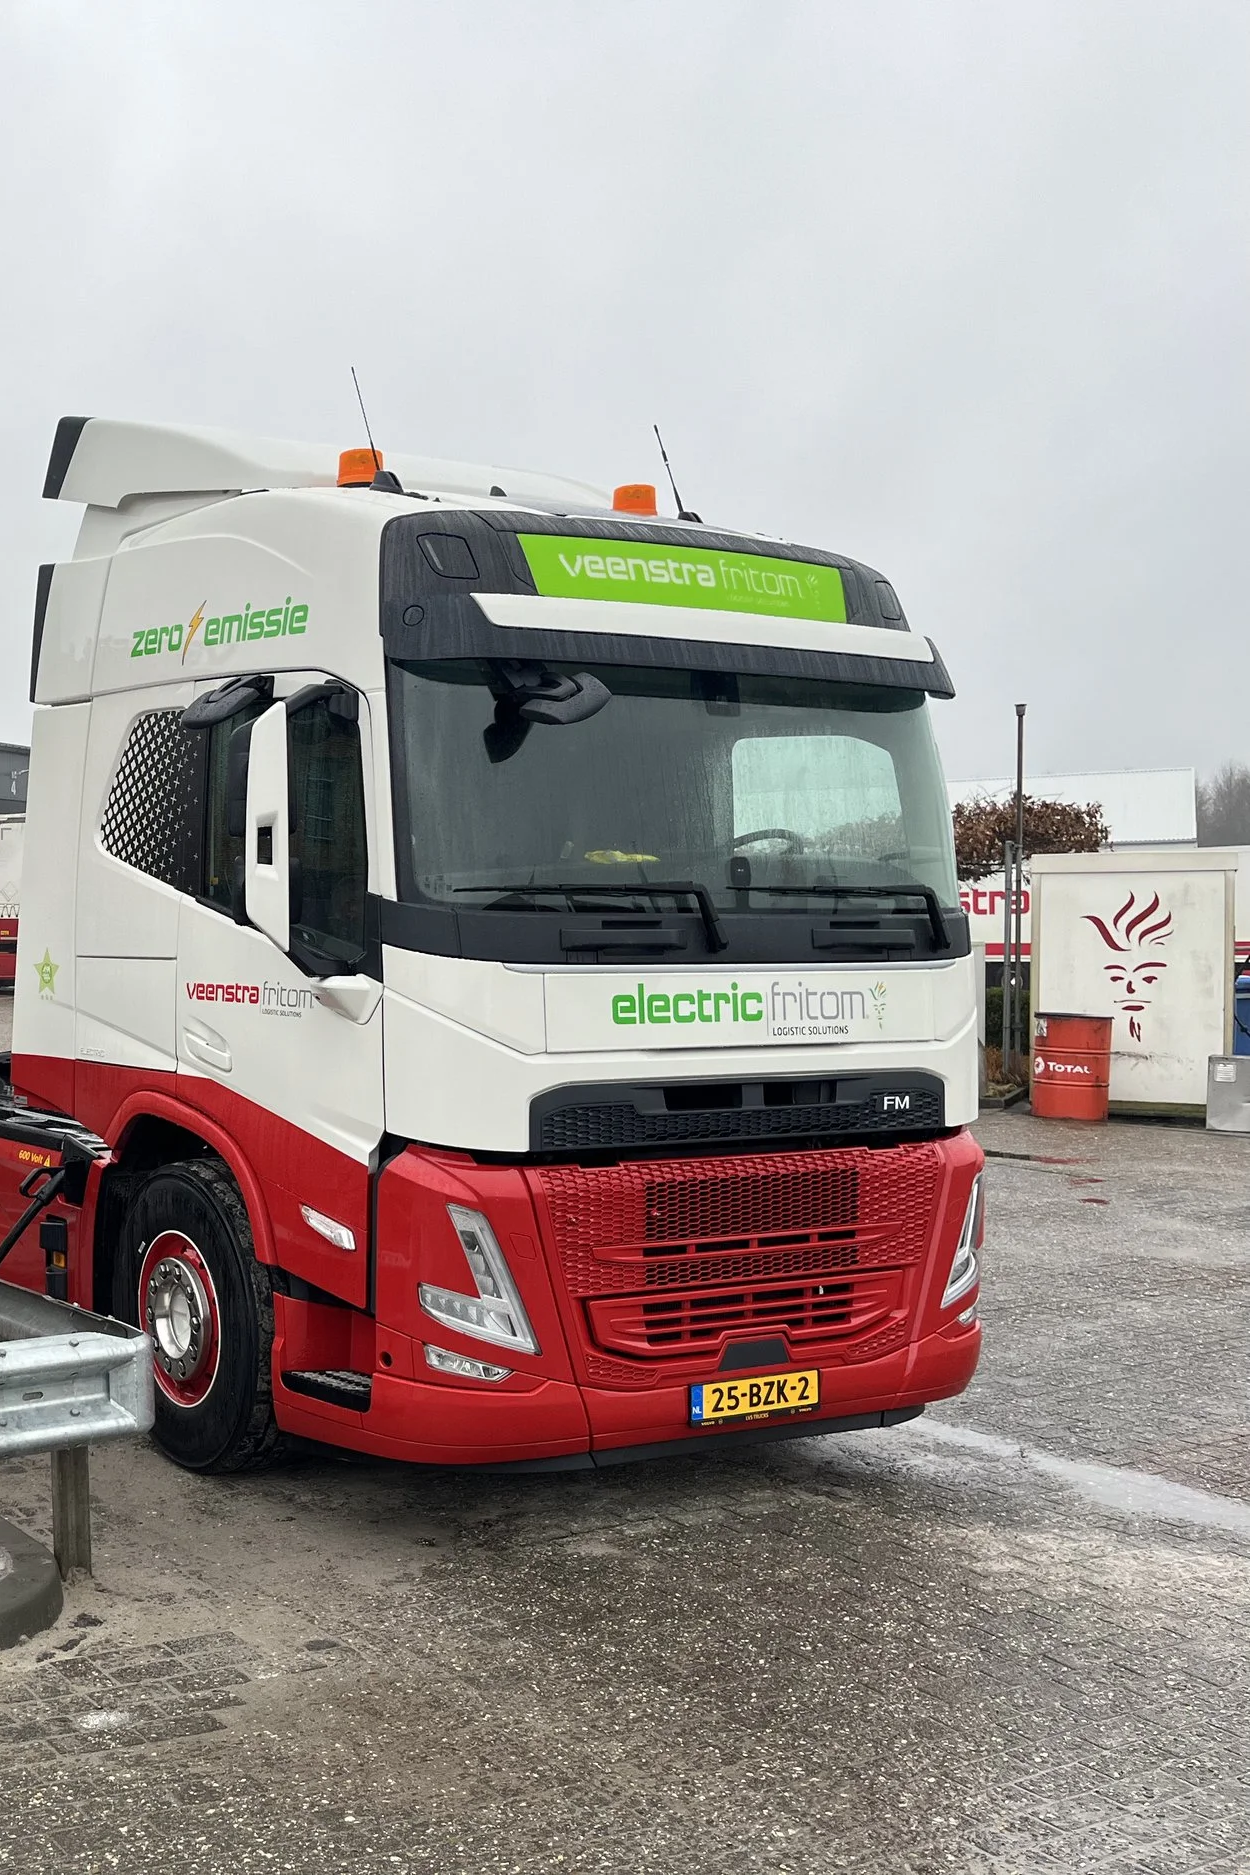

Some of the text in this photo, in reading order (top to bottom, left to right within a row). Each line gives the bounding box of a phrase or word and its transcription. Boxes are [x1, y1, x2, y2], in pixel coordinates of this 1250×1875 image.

[558, 553, 803, 598] veenstra fritom
[131, 596, 309, 657] zero emissie
[10, 780, 16, 795] 4
[186, 980, 313, 1008] veenstra fritom
[611, 981, 866, 1024] electric fritom
[262, 1008, 302, 1018] LOGISTIC SOLUTIONS
[772, 1025, 849, 1036] LOGISTIC SOLUTIONS
[1047, 1061, 1091, 1074] TOTAL
[883, 1095, 910, 1110] FM
[18, 1150, 44, 1164] 600 Volt
[711, 1376, 810, 1413] 25-BZK-2
[692, 1406, 702, 1414] NL
